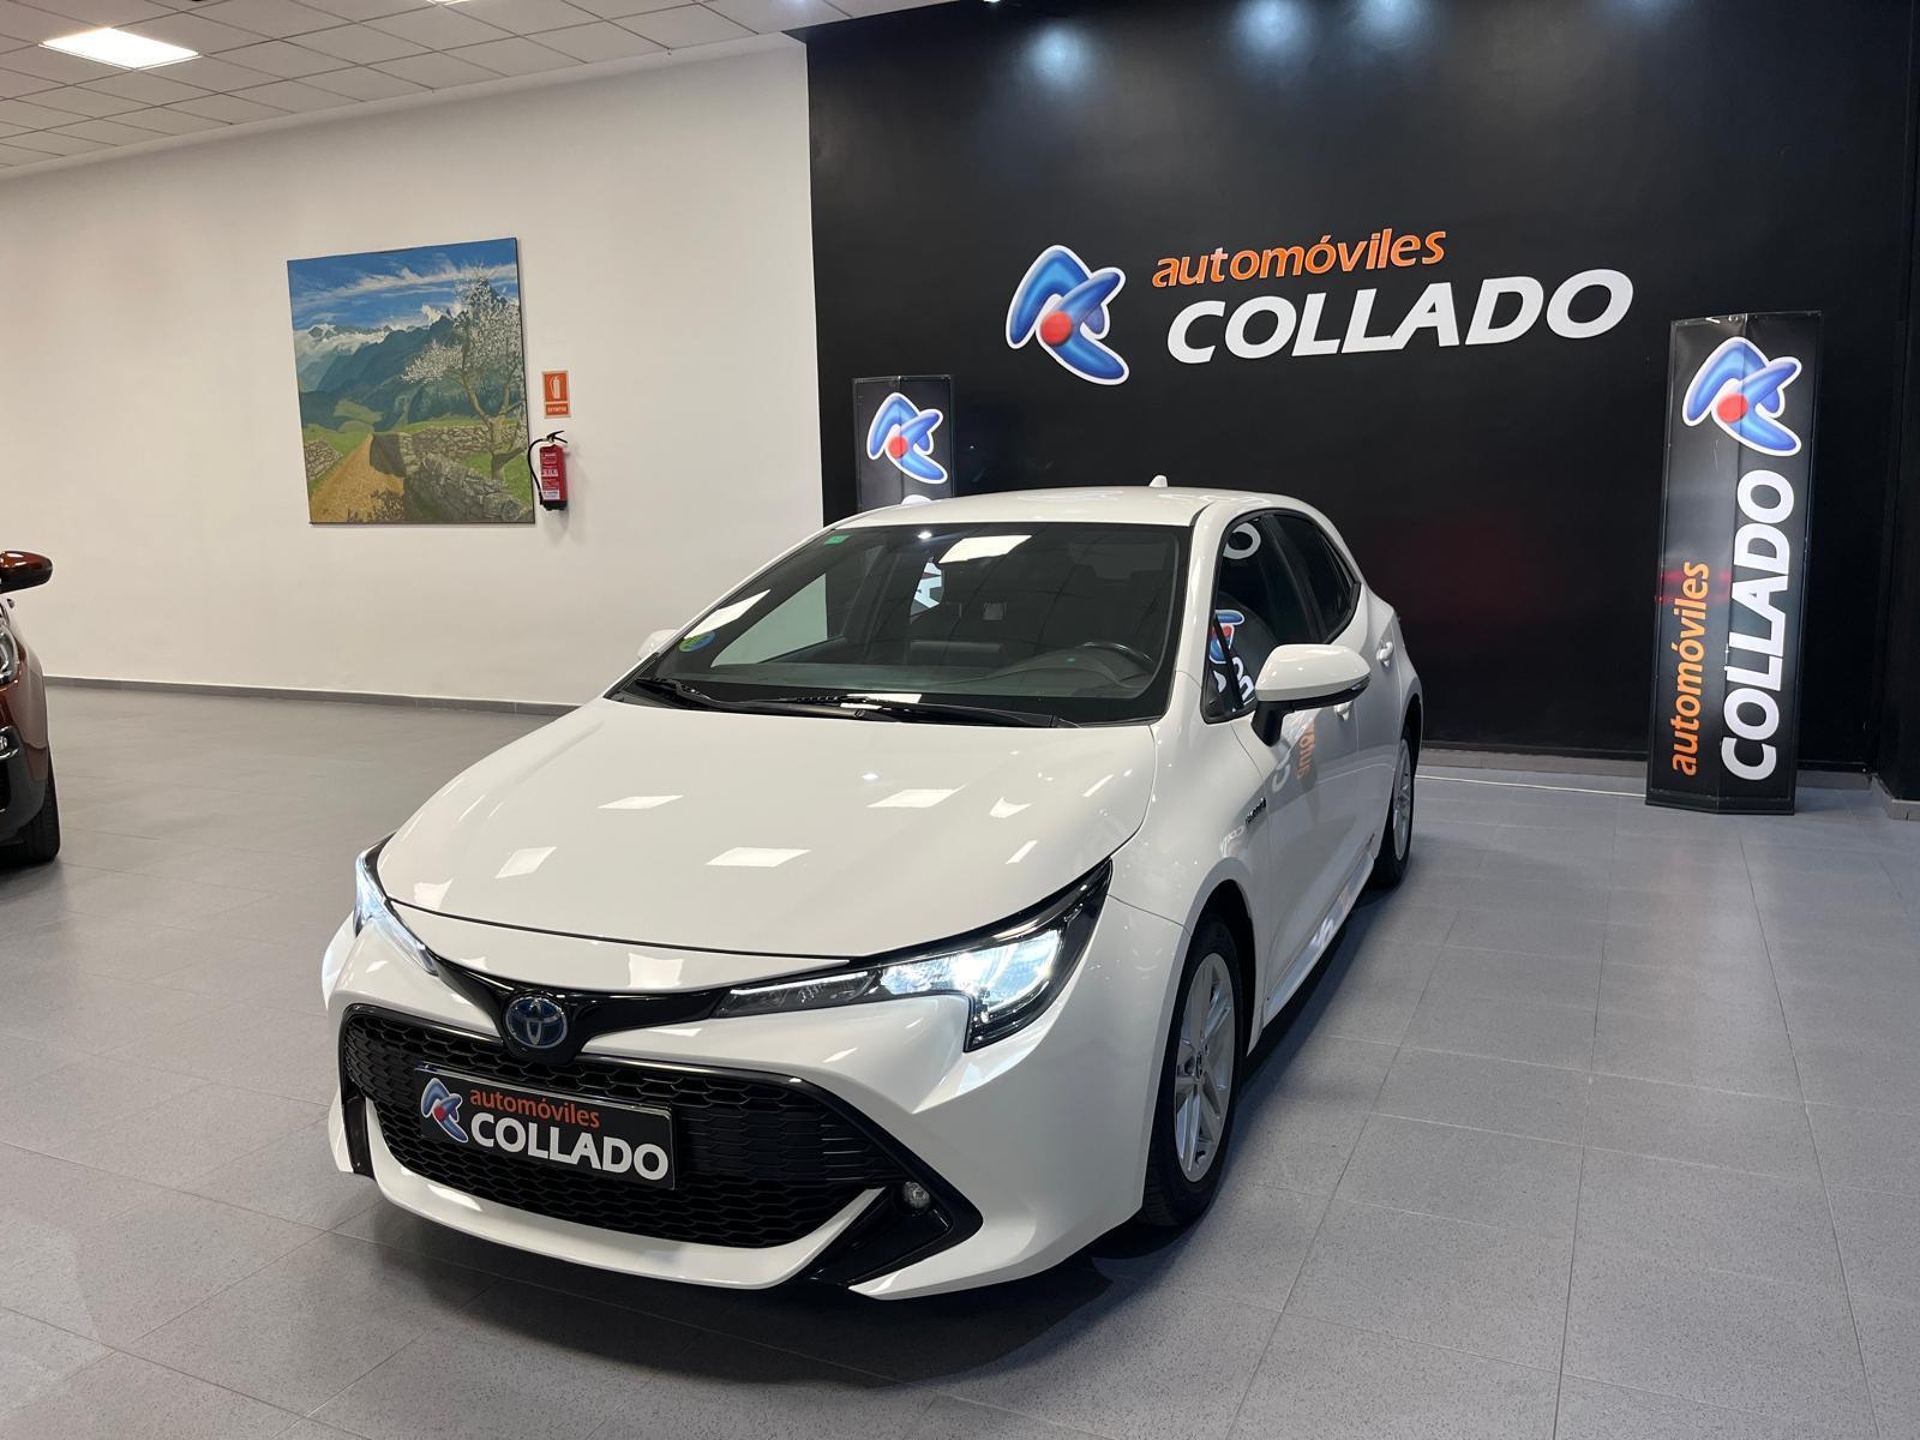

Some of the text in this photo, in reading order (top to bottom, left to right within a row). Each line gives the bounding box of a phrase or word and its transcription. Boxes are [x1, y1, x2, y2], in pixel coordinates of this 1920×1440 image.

[1152, 228, 1447, 288] automóviles
[1167, 268, 1634, 364] COLLADO
[1721, 469, 1795, 781] COLLADO
[1671, 561, 1710, 777] automóviles
[469, 1088, 601, 1129] automóviles
[471, 1112, 669, 1181] COLLADO
